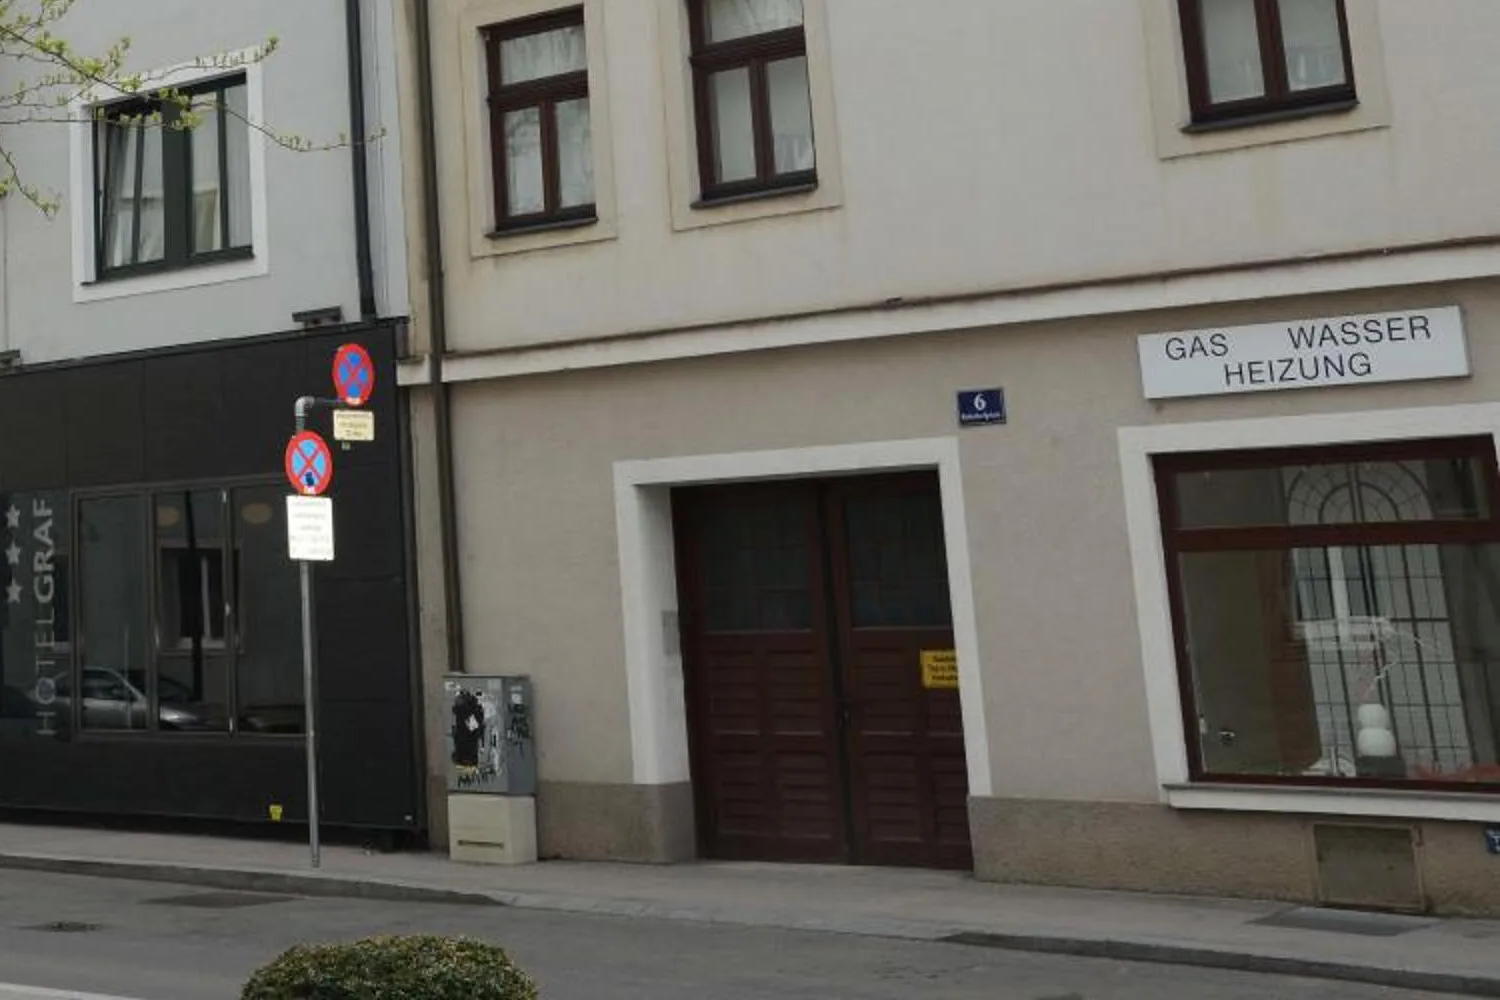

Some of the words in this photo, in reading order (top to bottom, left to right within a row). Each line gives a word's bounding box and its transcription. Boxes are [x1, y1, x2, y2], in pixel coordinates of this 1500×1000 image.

[1164, 332, 1229, 361] GAS
[1287, 315, 1432, 351] WASSER
[1223, 351, 1373, 387] HEIZUNG
[973, 393, 987, 411] 6
[33, 497, 55, 604] GRAF
[34, 606, 57, 737] HOTEL
